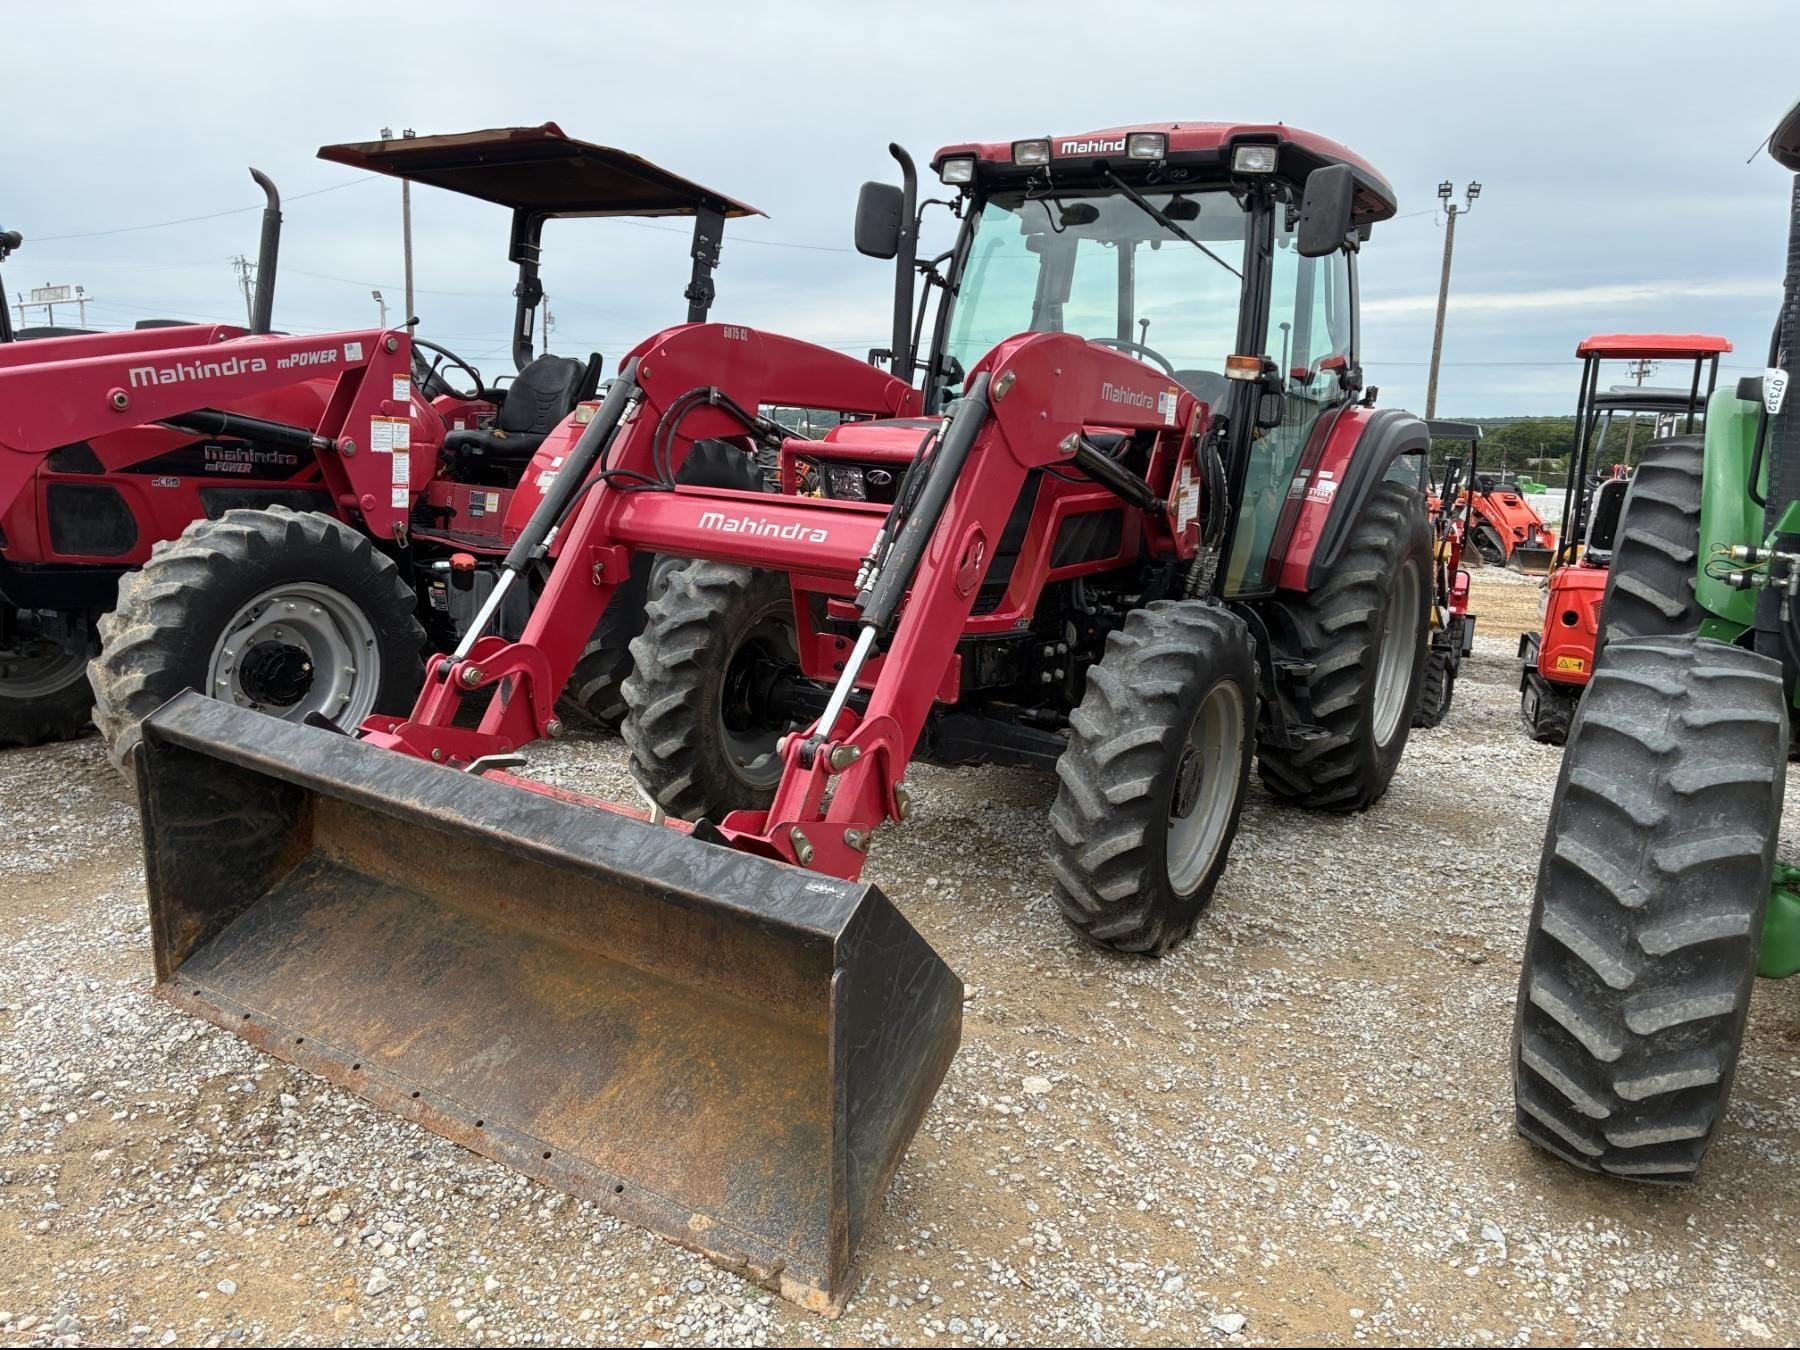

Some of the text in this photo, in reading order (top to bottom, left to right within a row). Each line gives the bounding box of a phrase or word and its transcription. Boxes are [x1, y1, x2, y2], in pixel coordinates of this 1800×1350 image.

[1061, 138, 1126, 154] Mahind
[129, 357, 267, 388] Mahindra
[277, 349, 337, 369] mPOWER
[1102, 381, 1154, 409] Mahindra
[1768, 379, 1784, 411] 07332
[204, 446, 298, 465] Mahindra
[204, 461, 253, 473] mPOWER
[698, 511, 828, 543] Mahindra
